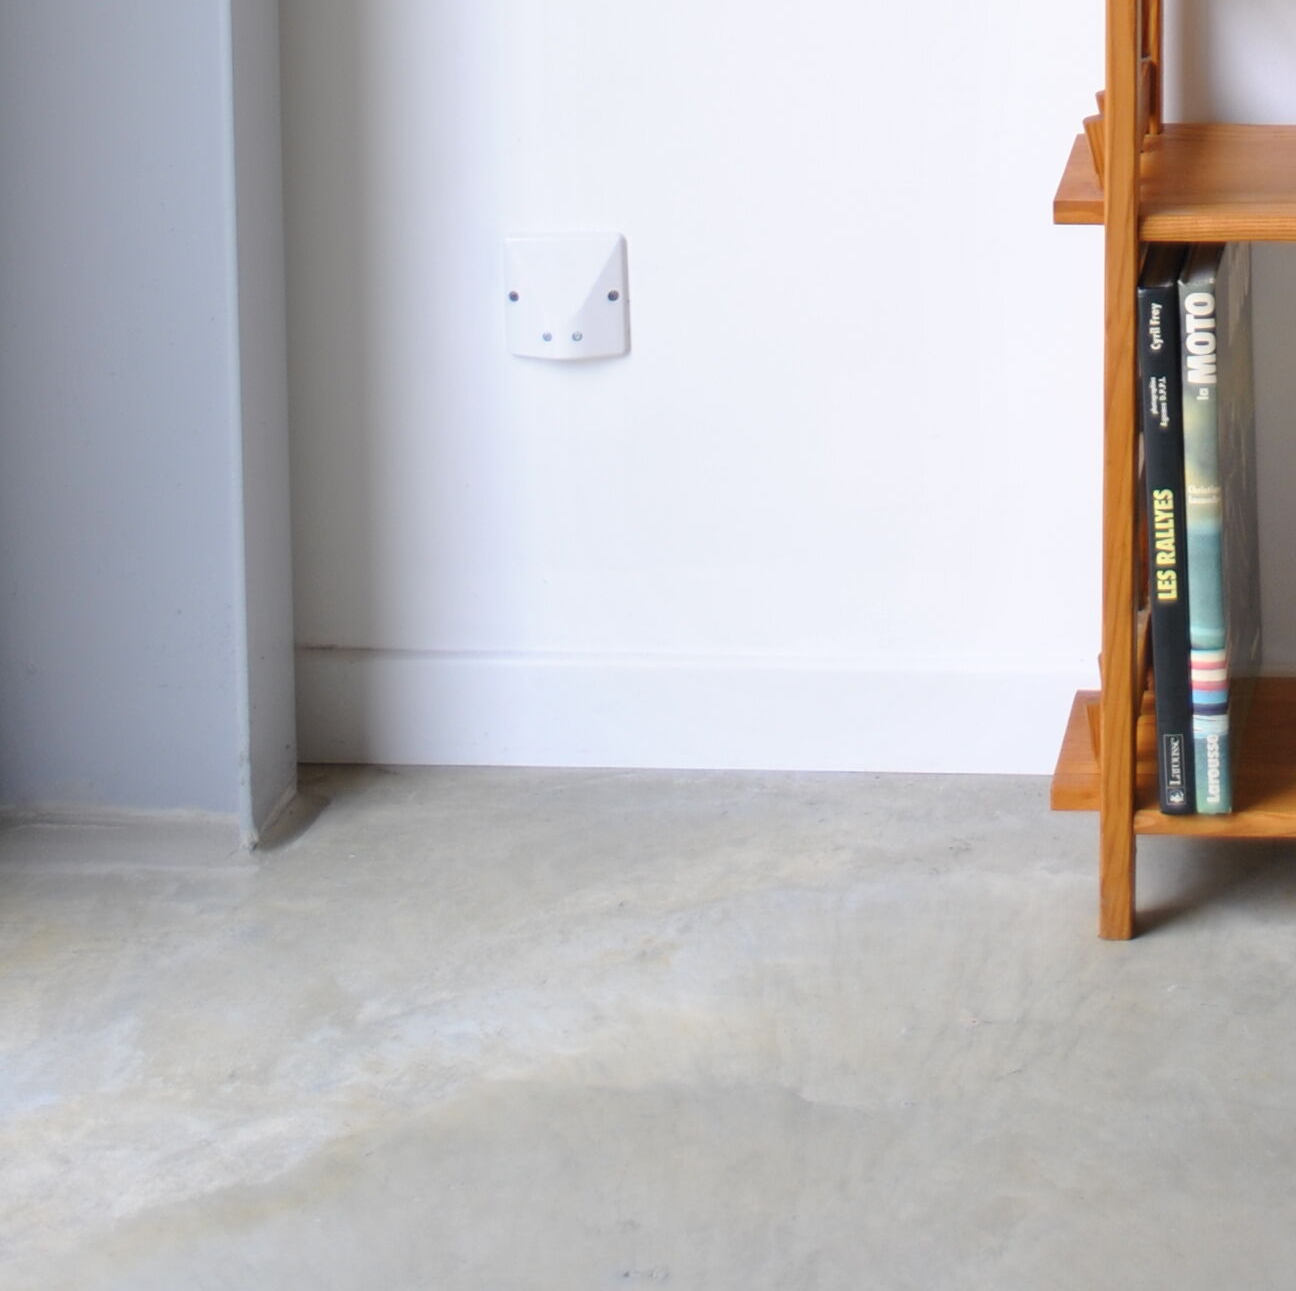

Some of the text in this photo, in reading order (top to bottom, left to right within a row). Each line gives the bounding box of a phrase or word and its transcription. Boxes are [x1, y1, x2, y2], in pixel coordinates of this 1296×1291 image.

[1149, 302, 1164, 350] Cyril Frey
[1184, 292, 1217, 400] la MOTO
[1154, 488, 1178, 601] LES RALLYES
[1168, 737, 1182, 786] Larousse
[1206, 733, 1220, 804] Larousse
